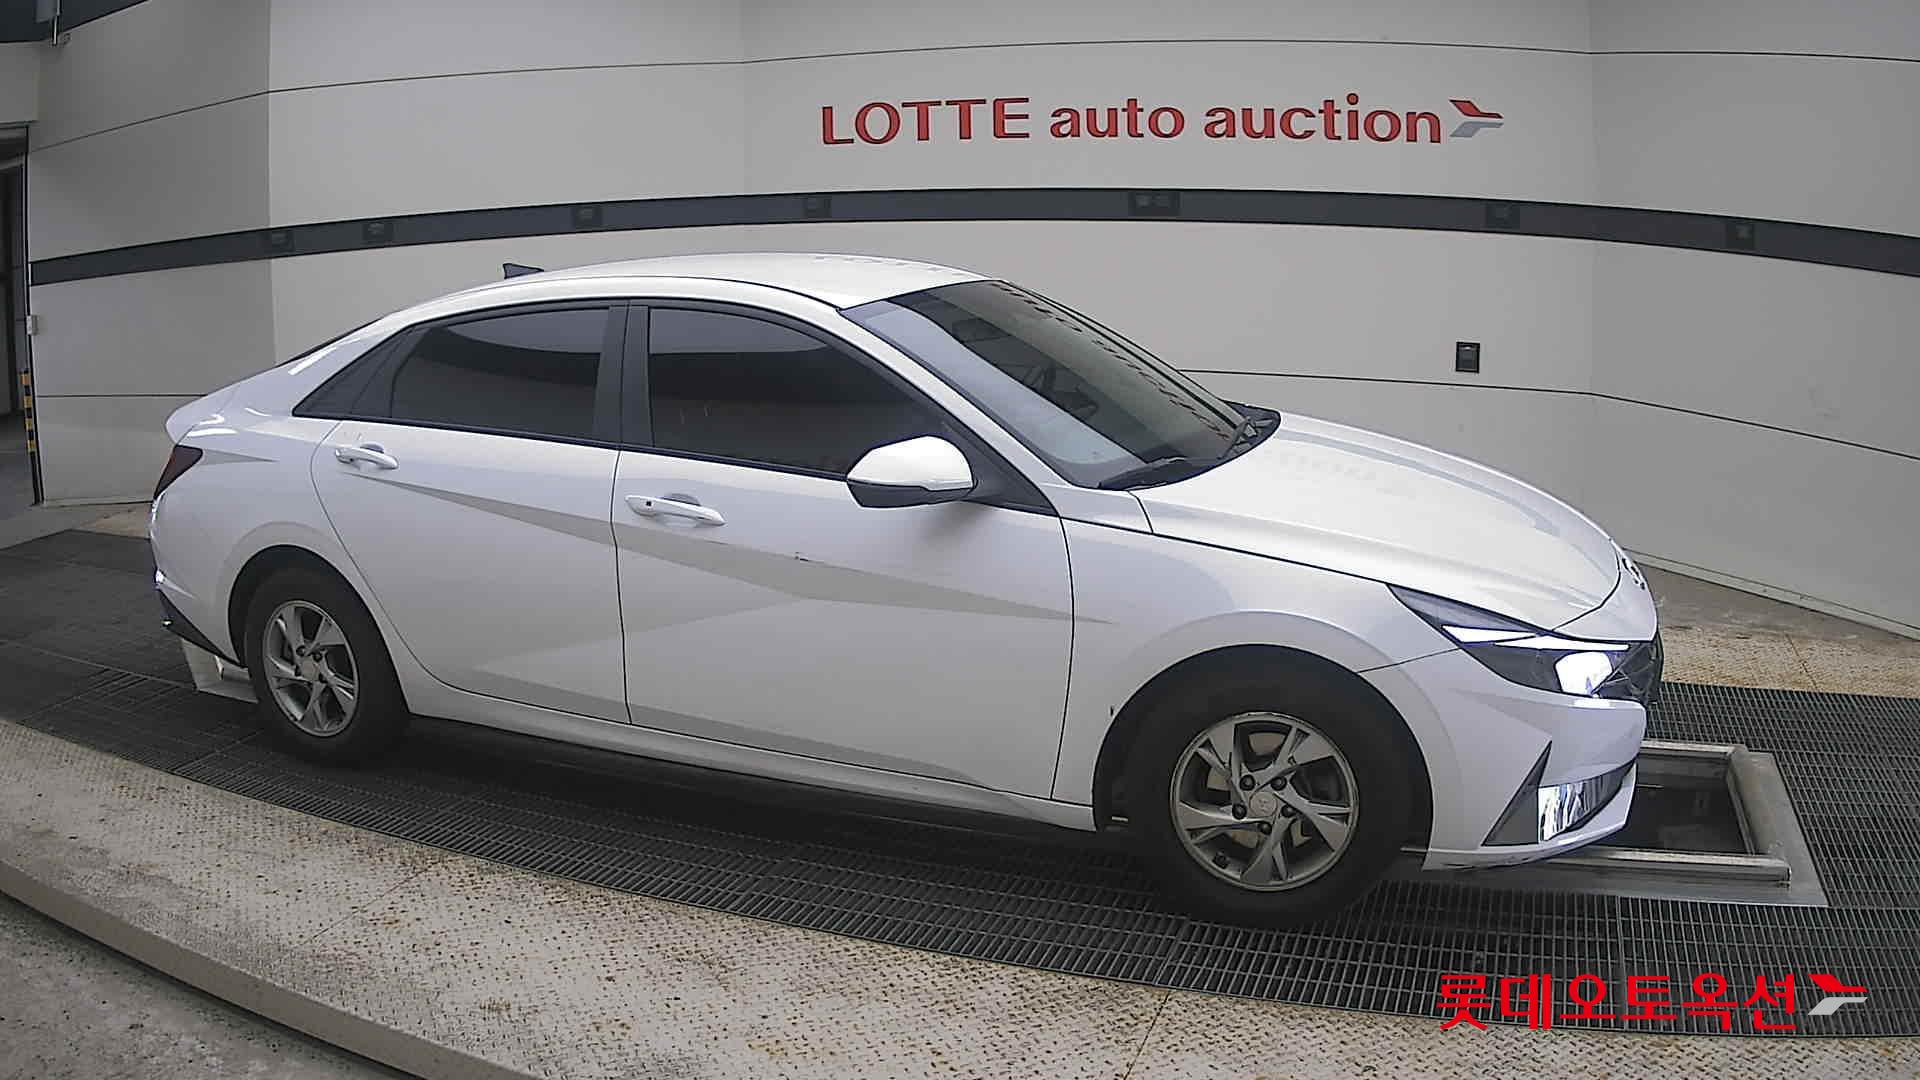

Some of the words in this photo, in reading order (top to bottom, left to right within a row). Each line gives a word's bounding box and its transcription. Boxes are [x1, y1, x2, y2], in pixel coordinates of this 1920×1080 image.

[822, 97, 1030, 145] LOTTE
[1050, 98, 1185, 138] auto
[1204, 93, 1442, 143] auction
